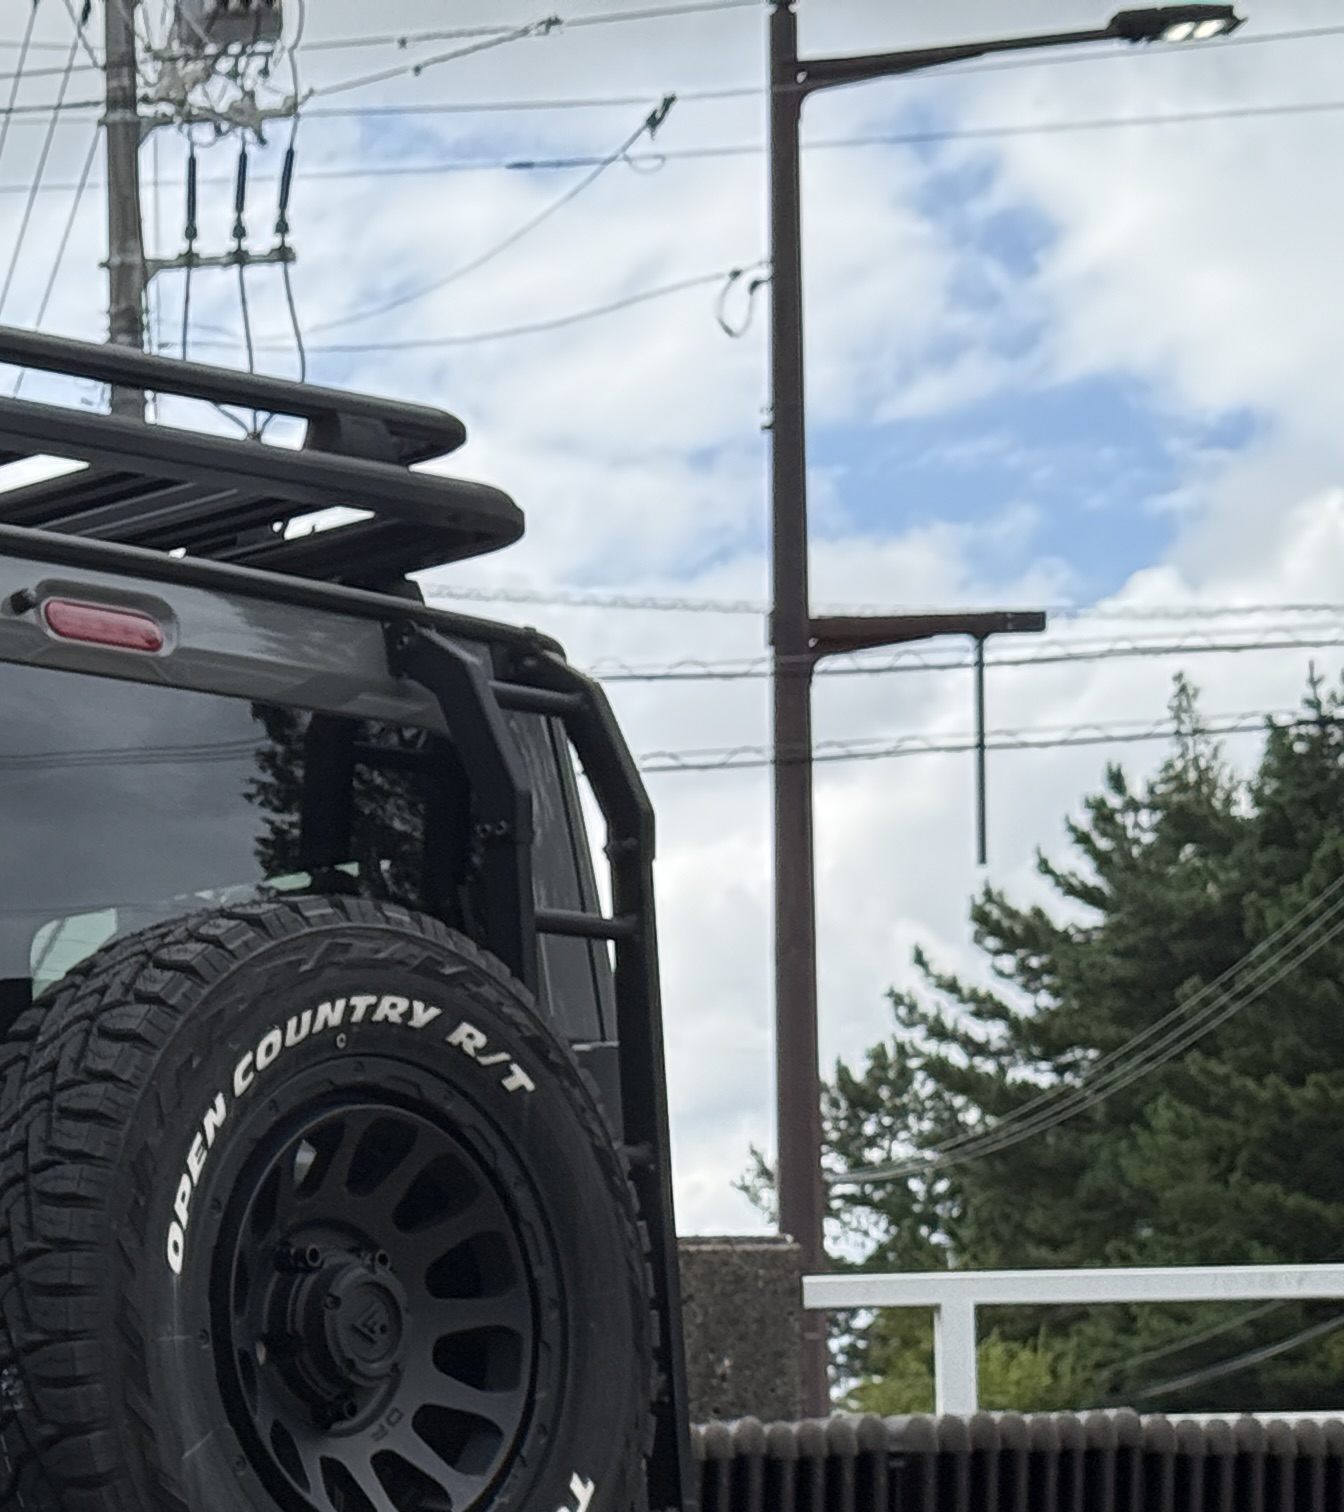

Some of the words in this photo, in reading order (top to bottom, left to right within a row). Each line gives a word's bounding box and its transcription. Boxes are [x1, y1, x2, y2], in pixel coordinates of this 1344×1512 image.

[167, 1093, 229, 1275] OPEN
[233, 994, 443, 1099] COUNTRY
[447, 1021, 538, 1096] R/T
